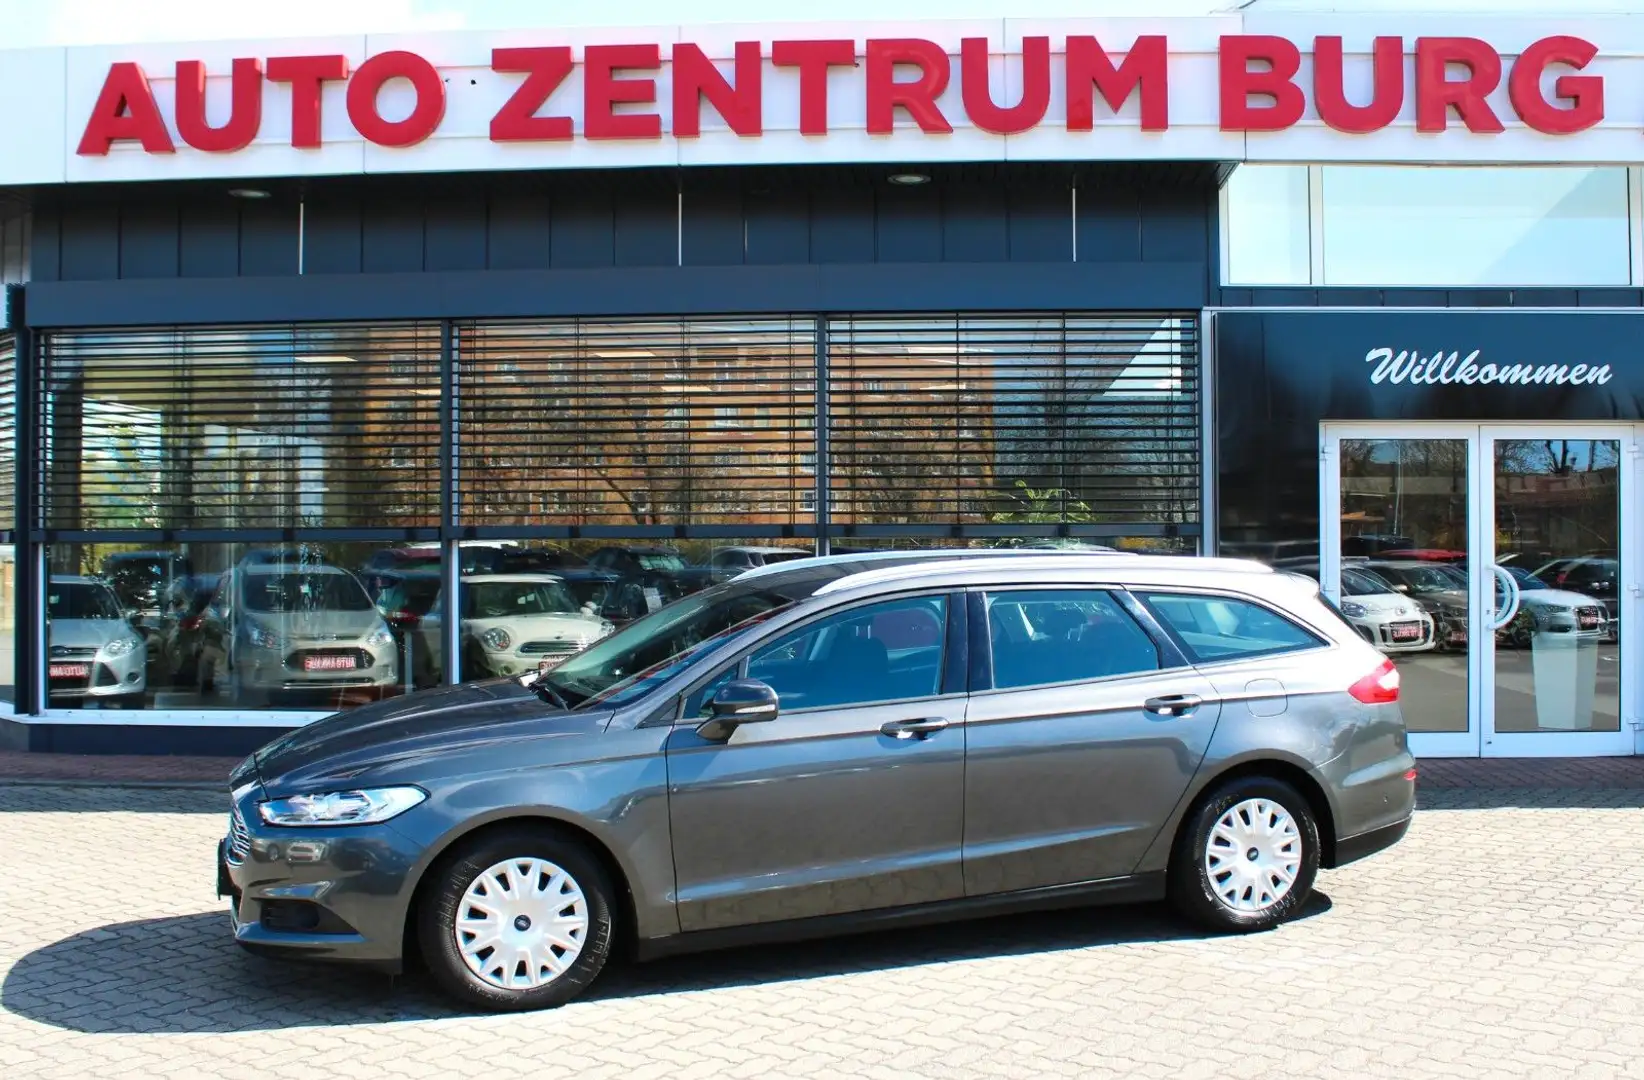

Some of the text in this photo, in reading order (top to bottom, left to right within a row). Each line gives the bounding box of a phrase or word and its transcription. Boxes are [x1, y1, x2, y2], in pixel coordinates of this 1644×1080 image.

[77, 35, 1605, 157] AUTO ZENTRUM BURG
[1364, 347, 1612, 386] Willkommen
